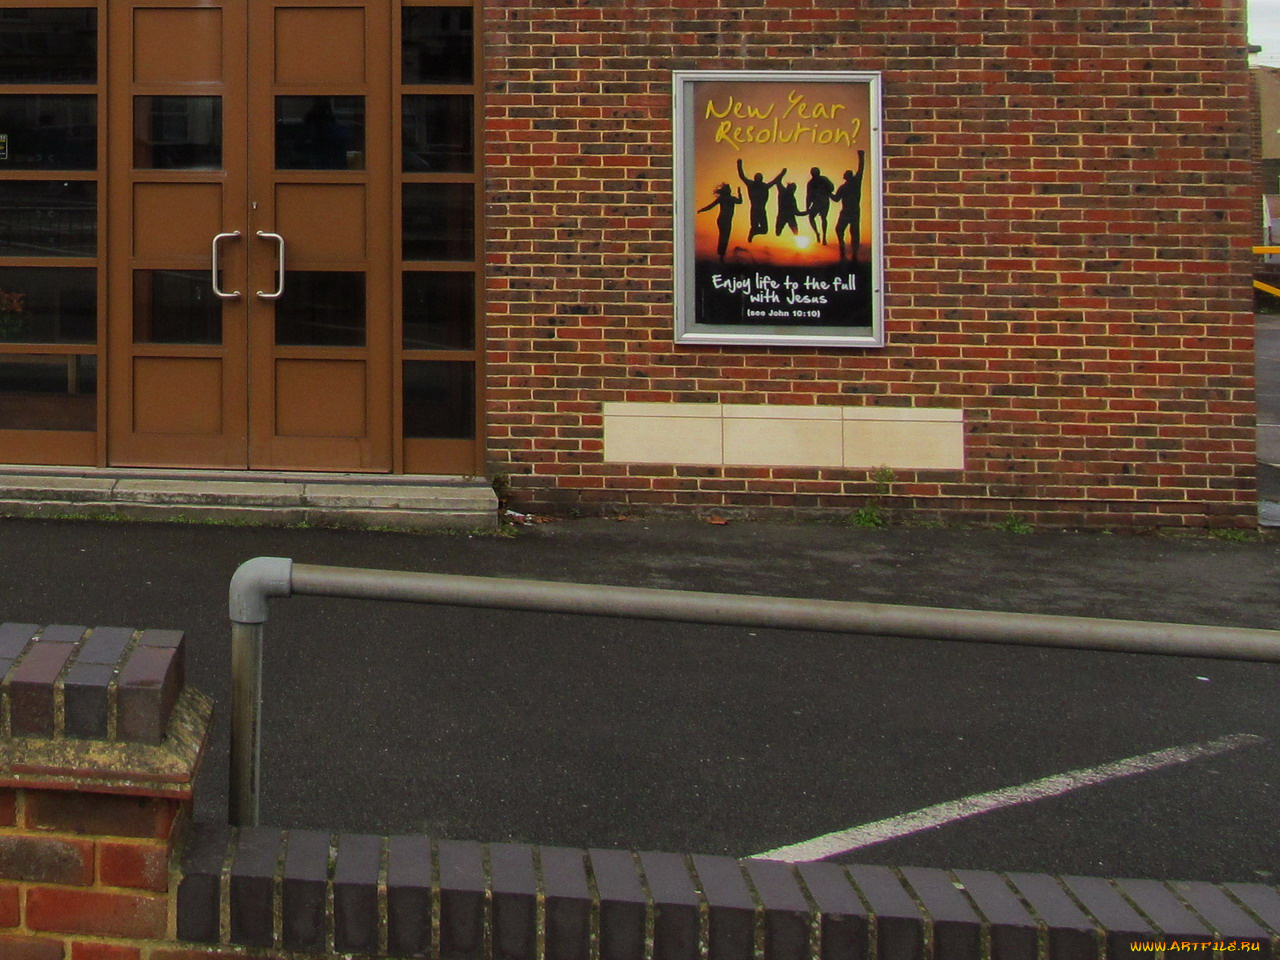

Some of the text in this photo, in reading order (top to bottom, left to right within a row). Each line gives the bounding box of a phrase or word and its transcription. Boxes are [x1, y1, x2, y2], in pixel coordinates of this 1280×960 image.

[705, 90, 846, 119] New Year
[715, 117, 861, 151] Resolution?
[712, 272, 856, 294] Enjoy life to the full
[750, 289, 828, 304] with Jesus
[747, 309, 766, 317] (see
[792, 310, 820, 318] 10:10)
